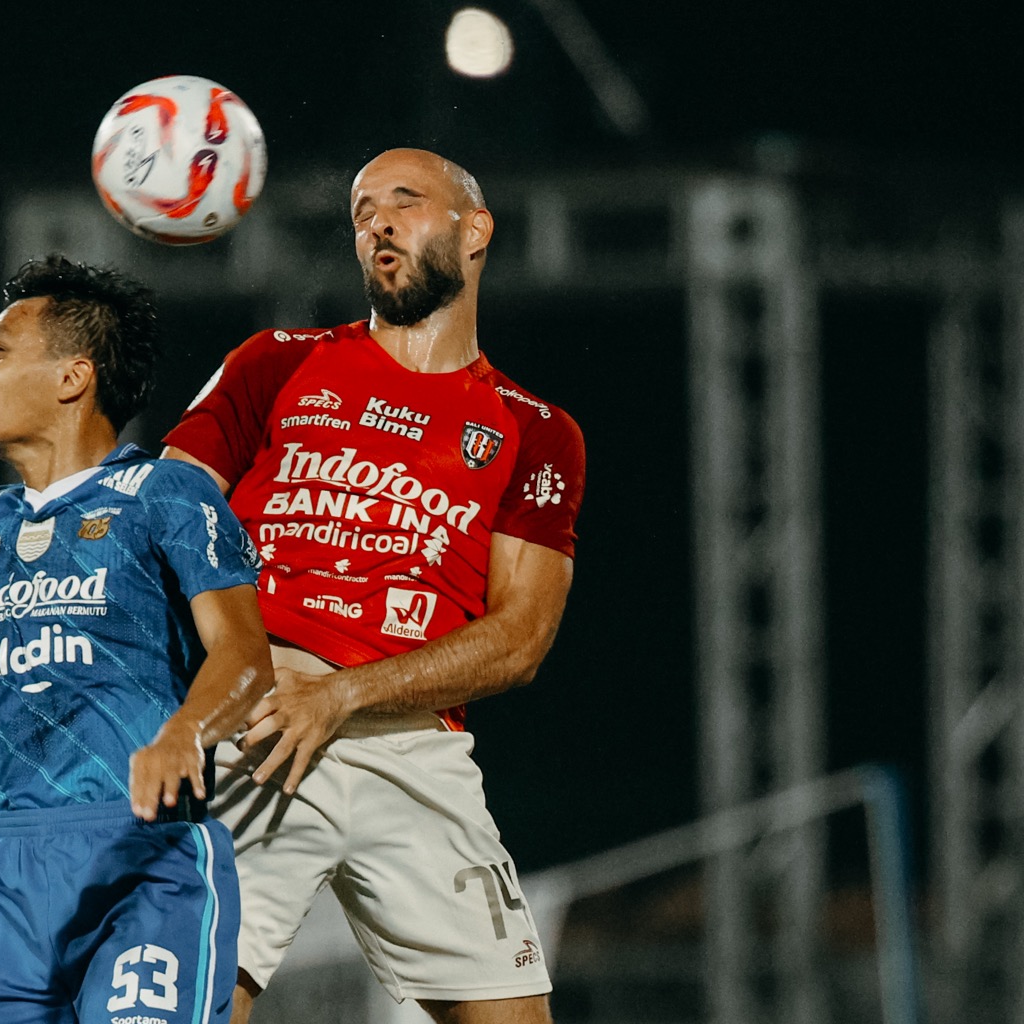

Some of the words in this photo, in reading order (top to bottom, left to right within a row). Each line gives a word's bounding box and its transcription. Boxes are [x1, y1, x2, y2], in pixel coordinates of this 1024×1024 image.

[297, 397, 343, 411] SPECS
[365, 396, 431, 426] Kuku
[280, 413, 352, 432] smartfren
[358, 411, 424, 442] Bima
[273, 442, 481, 536] Indofood
[262, 487, 380, 523] BANK
[387, 503, 451, 546] INA
[259, 520, 420, 556] mandiricoal
[66, 605, 108, 617] BERMUTU
[106, 943, 180, 1014] 53
